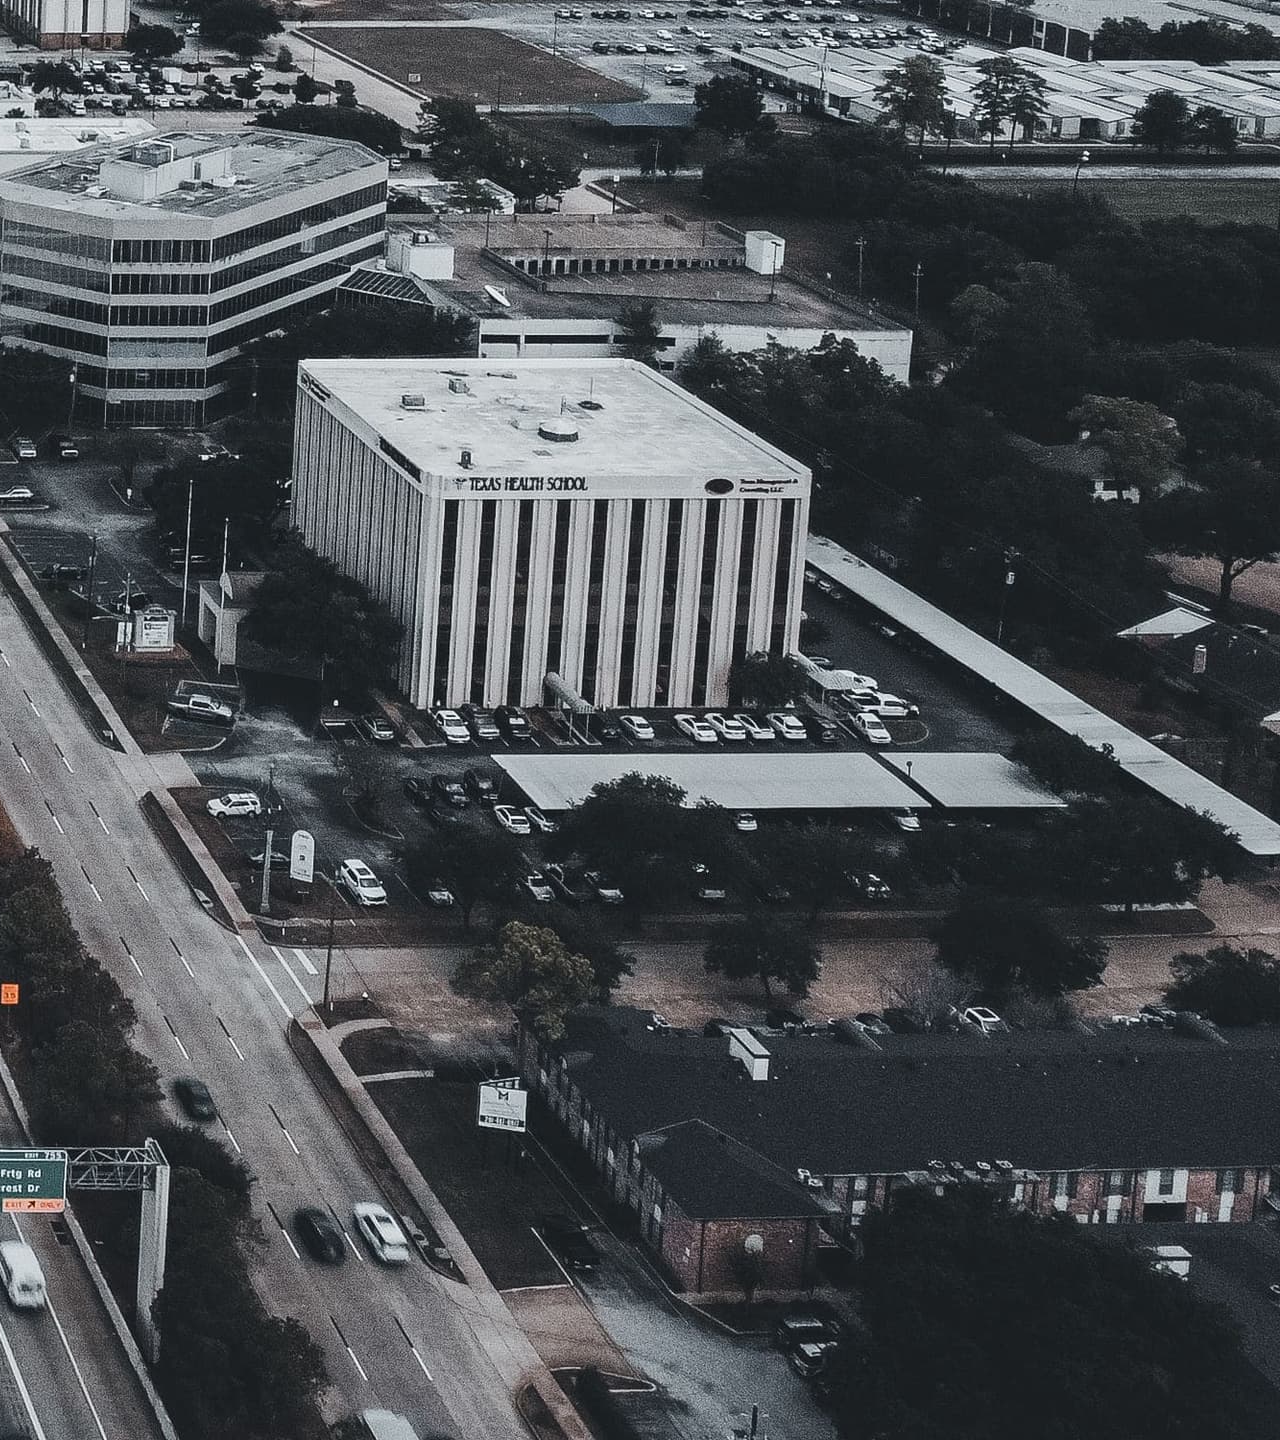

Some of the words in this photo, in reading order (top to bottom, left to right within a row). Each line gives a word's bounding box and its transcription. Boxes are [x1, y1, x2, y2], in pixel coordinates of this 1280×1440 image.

[469, 477, 501, 491] TEXAS
[505, 477, 543, 491] HEALTH
[547, 477, 588, 491] SCHOOL
[0, 1169, 22, 1180] Frtg
[27, 1169, 42, 1178] Rd
[27, 1184, 40, 1193] Dr
